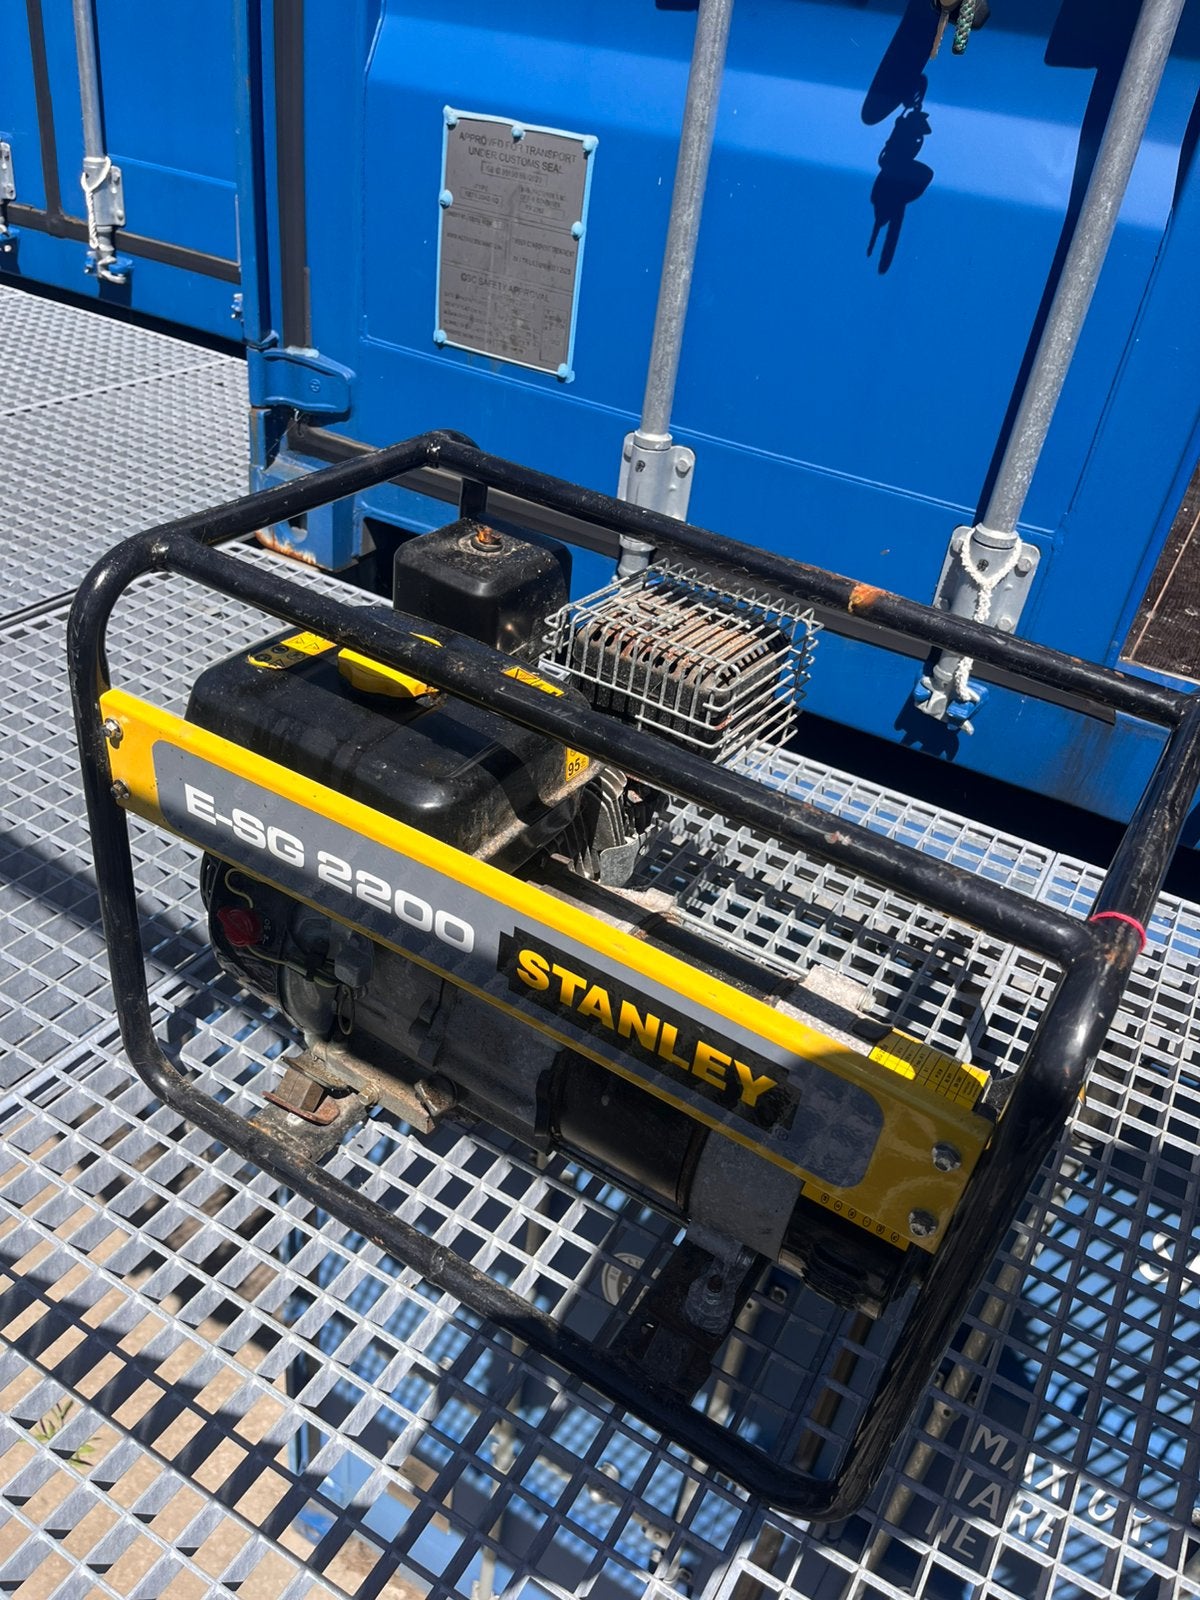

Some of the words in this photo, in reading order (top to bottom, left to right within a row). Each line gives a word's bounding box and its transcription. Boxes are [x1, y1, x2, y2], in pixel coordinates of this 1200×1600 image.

[468, 146, 498, 160] UNDER
[498, 151, 541, 169] CUSTOMS
[525, 145, 577, 164] TRANSPORT
[568, 757, 580, 776] 95
[184, 783, 306, 870] E-SG
[316, 850, 476, 954] 2200
[515, 948, 778, 1108] STANLEY
